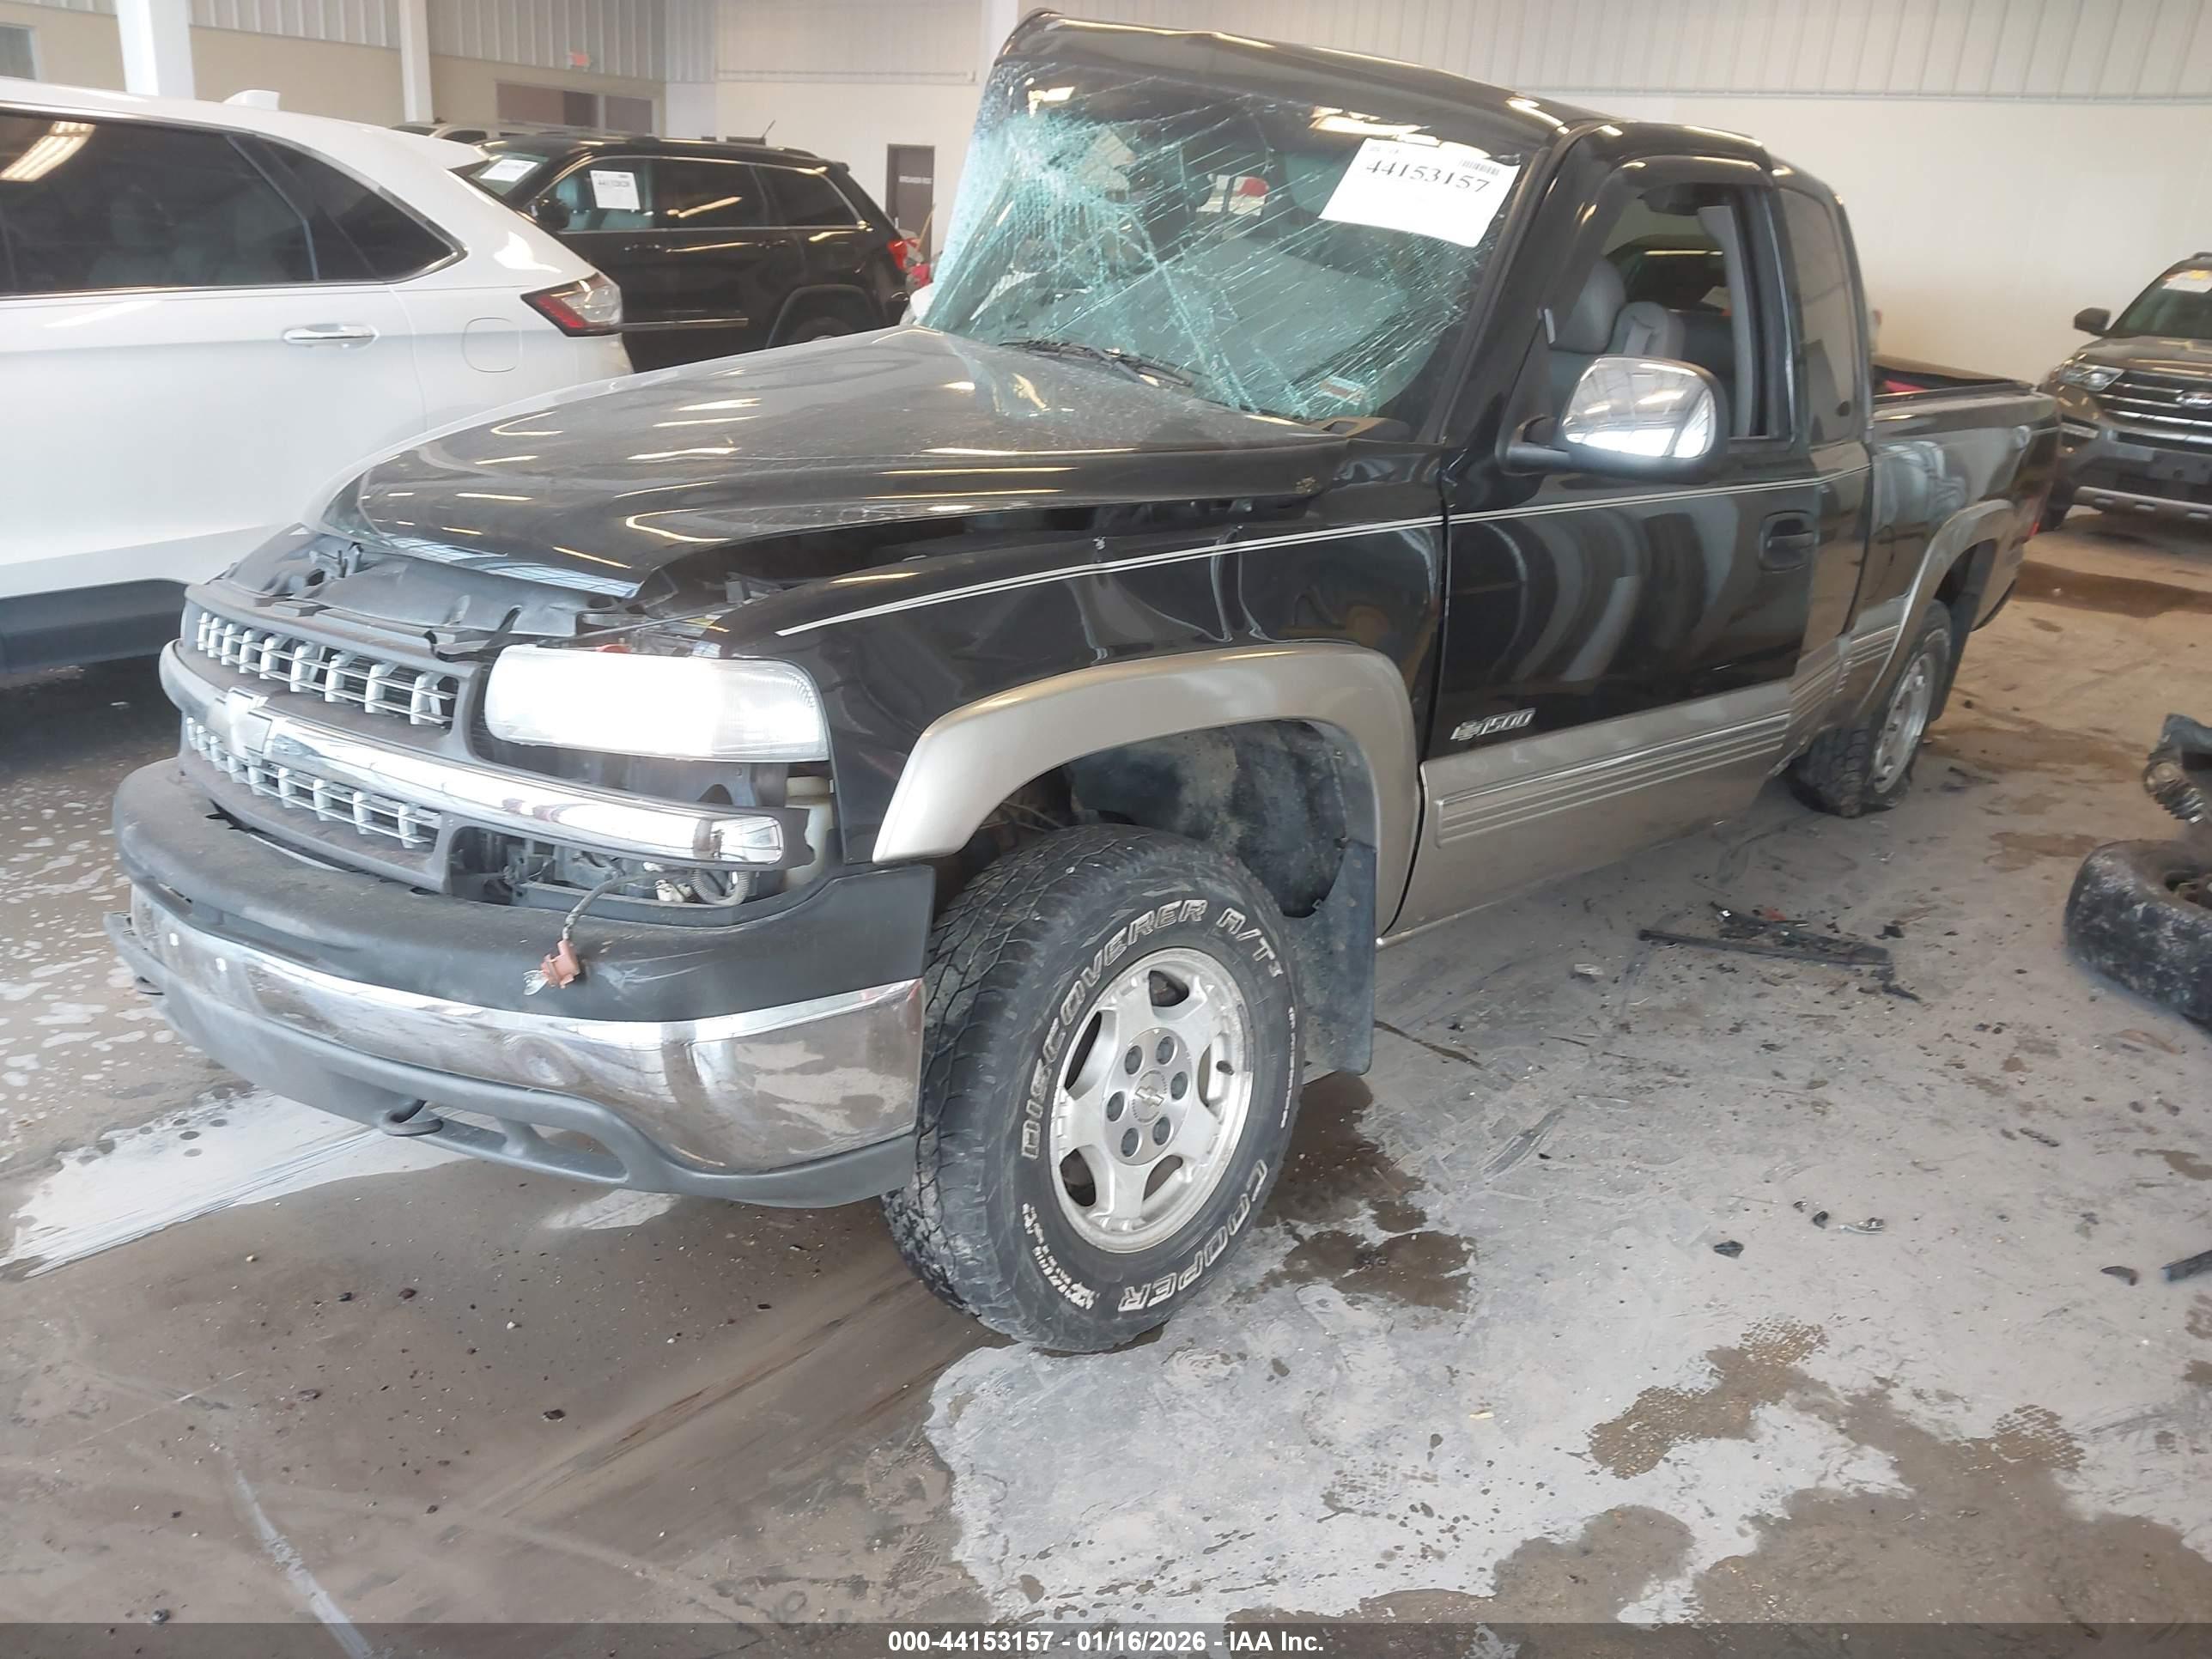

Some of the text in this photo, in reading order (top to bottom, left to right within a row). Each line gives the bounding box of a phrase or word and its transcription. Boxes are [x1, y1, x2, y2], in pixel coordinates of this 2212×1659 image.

[1365, 160, 1490, 192] 44153157
[1477, 707, 1536, 736] 1500
[1020, 898, 1207, 1160] DISCOVERER
[1117, 1159, 1268, 1312] COOPER
